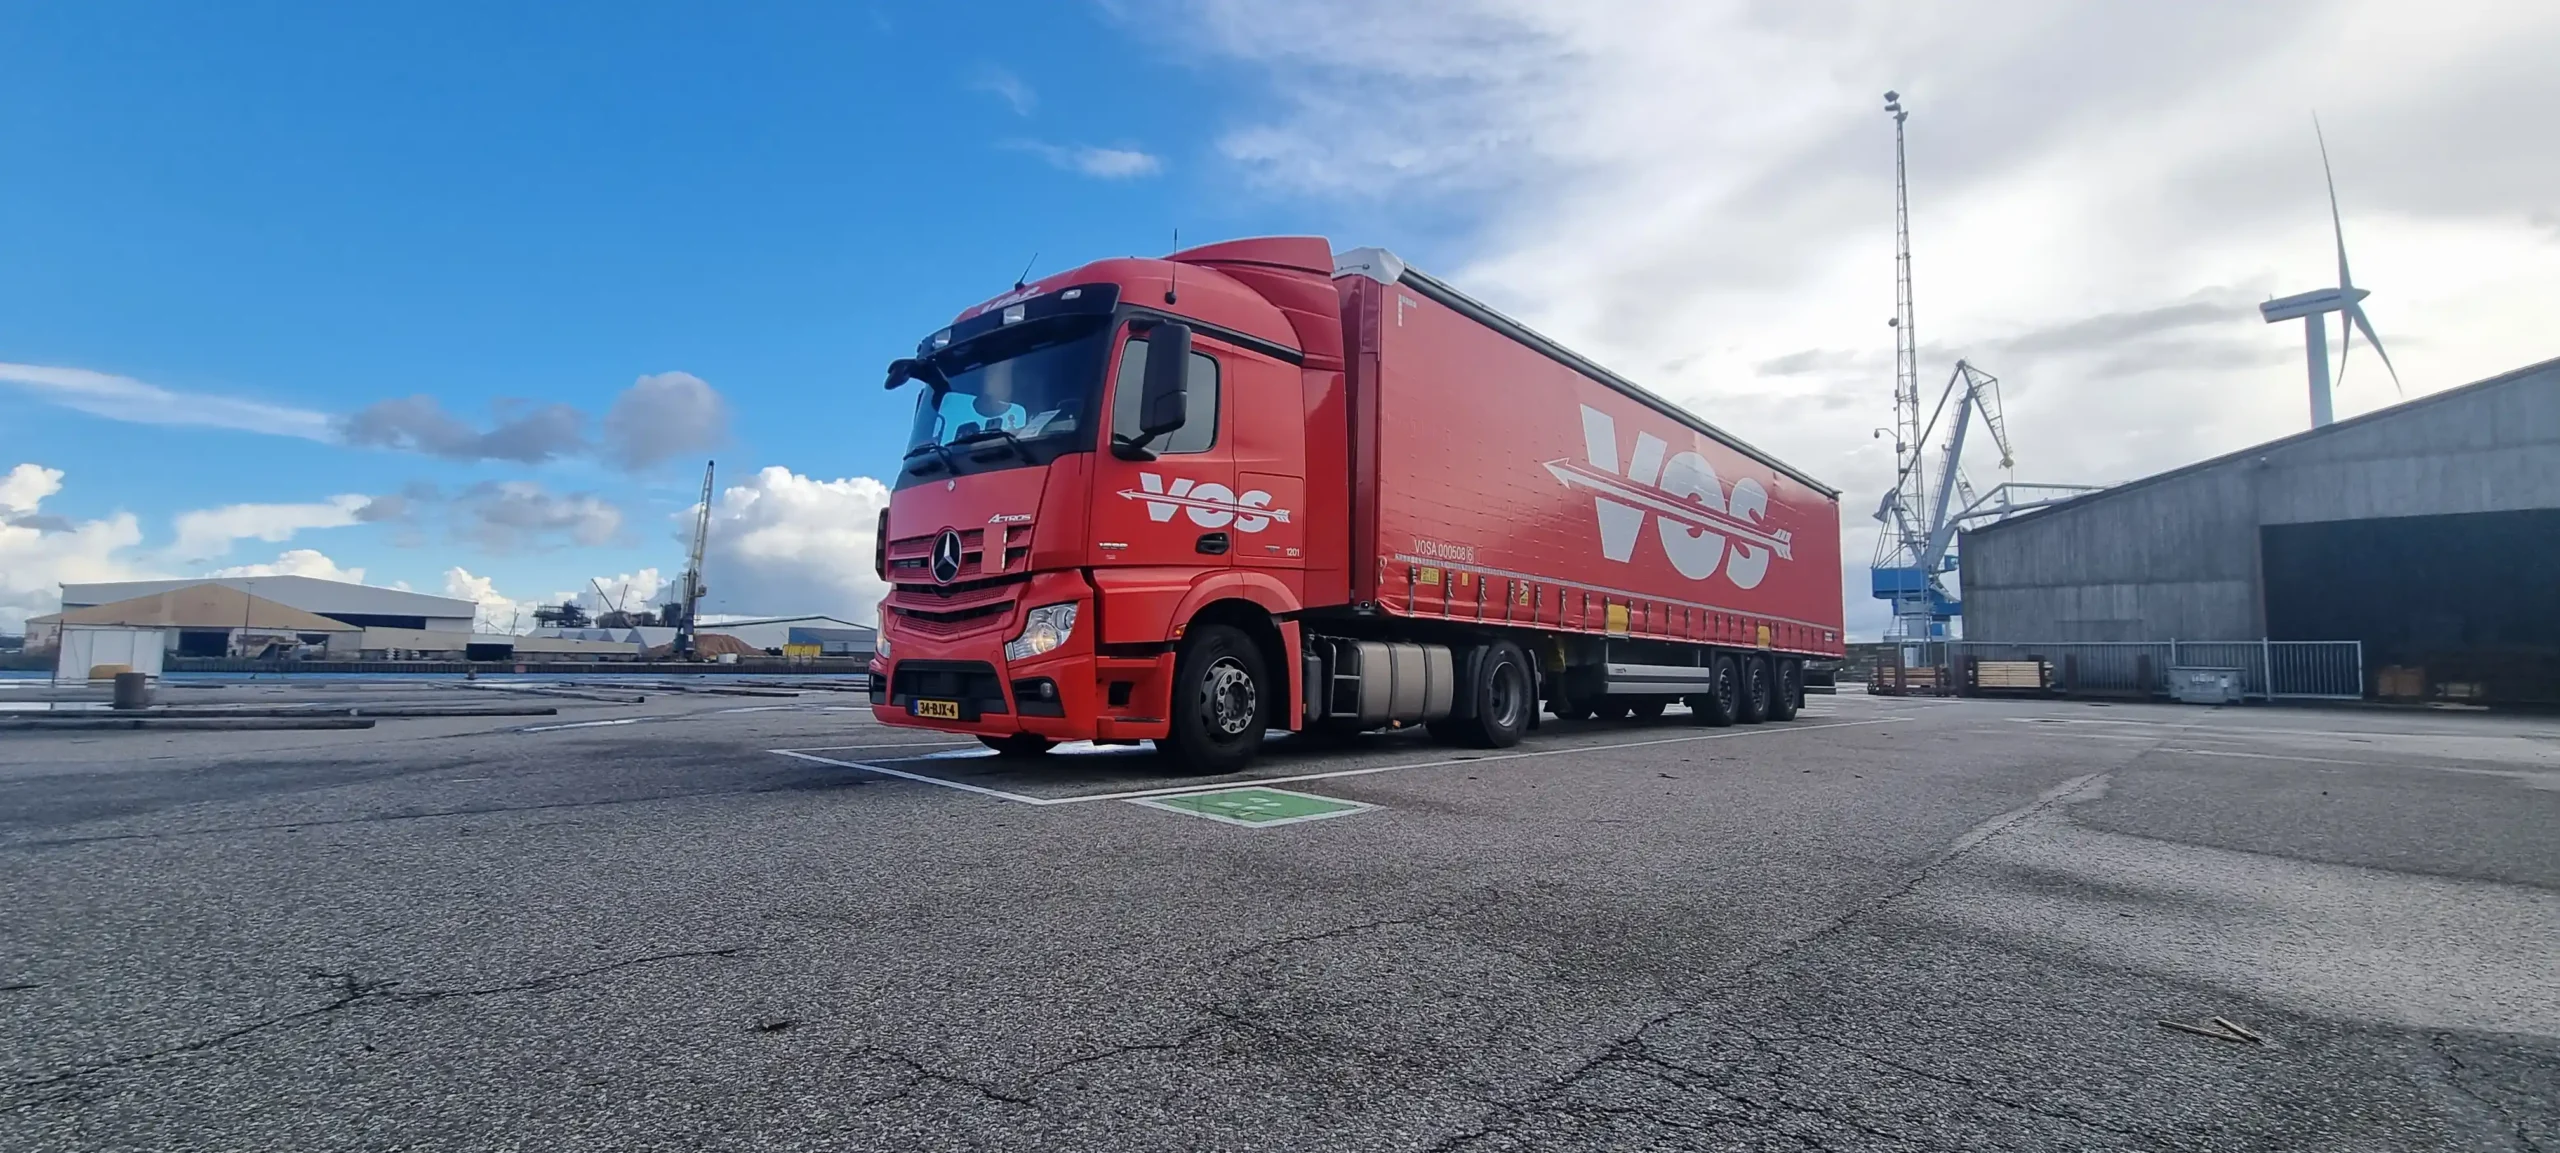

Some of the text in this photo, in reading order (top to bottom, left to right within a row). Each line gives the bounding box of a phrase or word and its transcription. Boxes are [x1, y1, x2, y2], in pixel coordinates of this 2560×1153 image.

[1139, 472, 1273, 533] VOS
[1580, 403, 1769, 589] VOS
[1286, 547, 1300, 557] 1201
[1414, 540, 1437, 556] VOSA
[1438, 543, 1466, 560] 000508
[920, 702, 955, 717] 34-BJX-4
